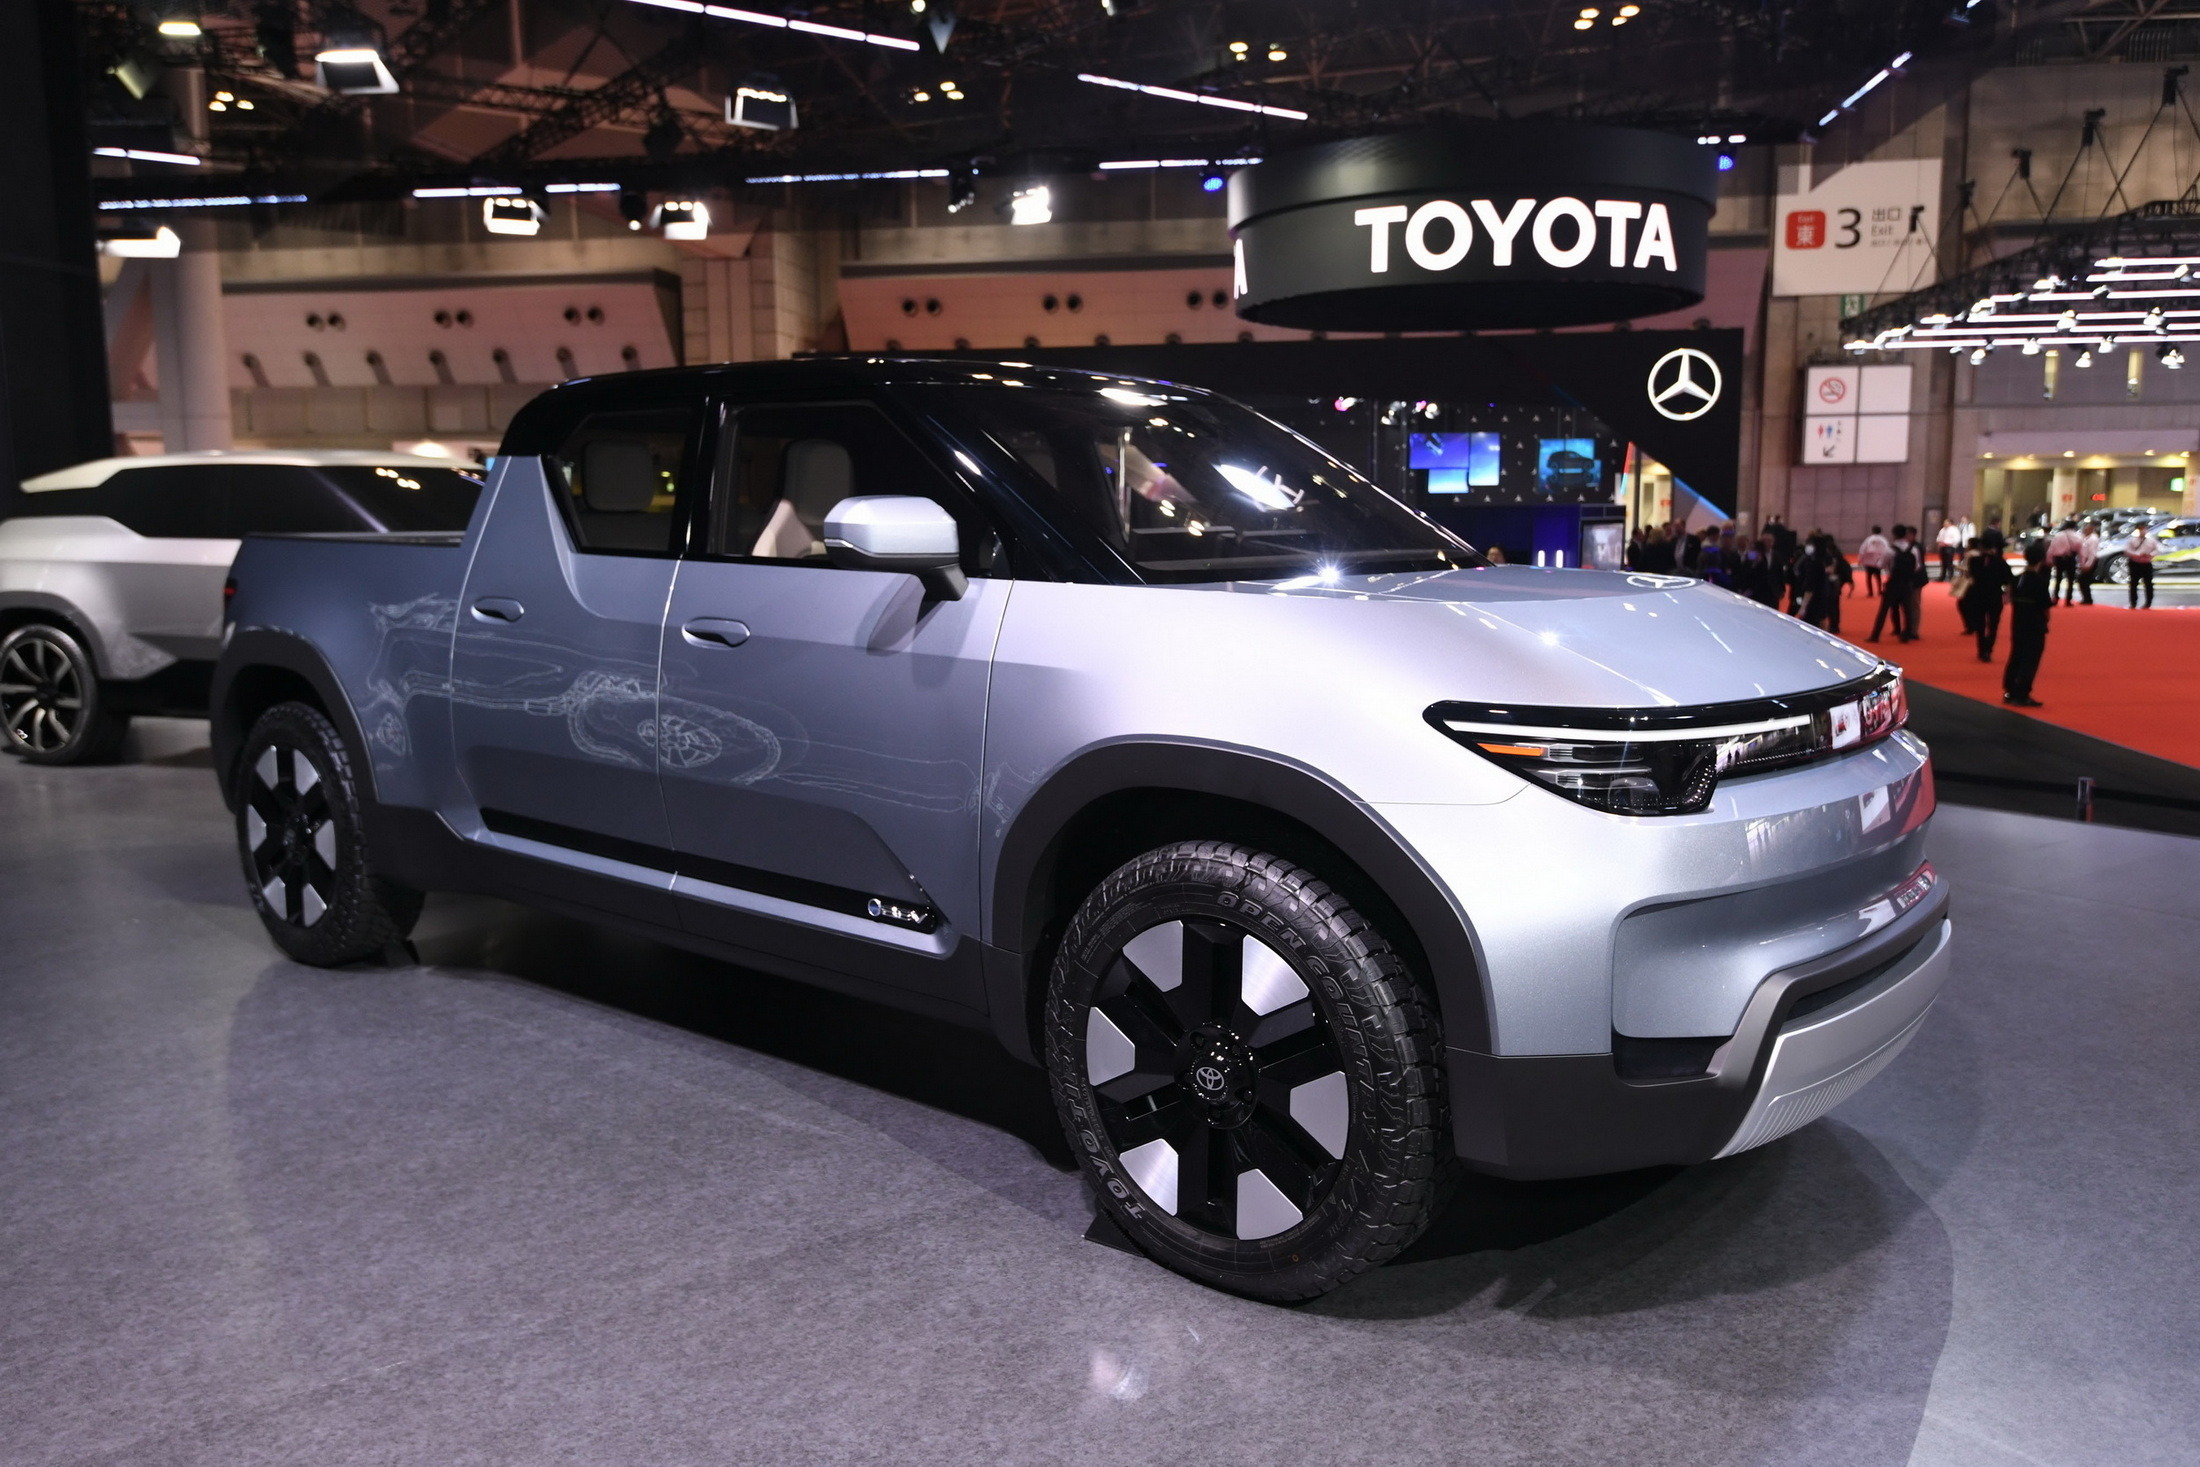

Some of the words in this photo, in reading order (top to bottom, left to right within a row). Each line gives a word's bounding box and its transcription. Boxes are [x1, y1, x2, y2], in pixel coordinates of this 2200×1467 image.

[1355, 196, 1677, 272] TOYOTA
[1835, 208, 1861, 248] 3
[1871, 226, 1892, 236] Exit
[1872, 207, 1901, 222] 出口
[1797, 225, 1815, 246] 東
[1216, 890, 1307, 950] OPEN
[1080, 1129, 1145, 1220] TOYO
